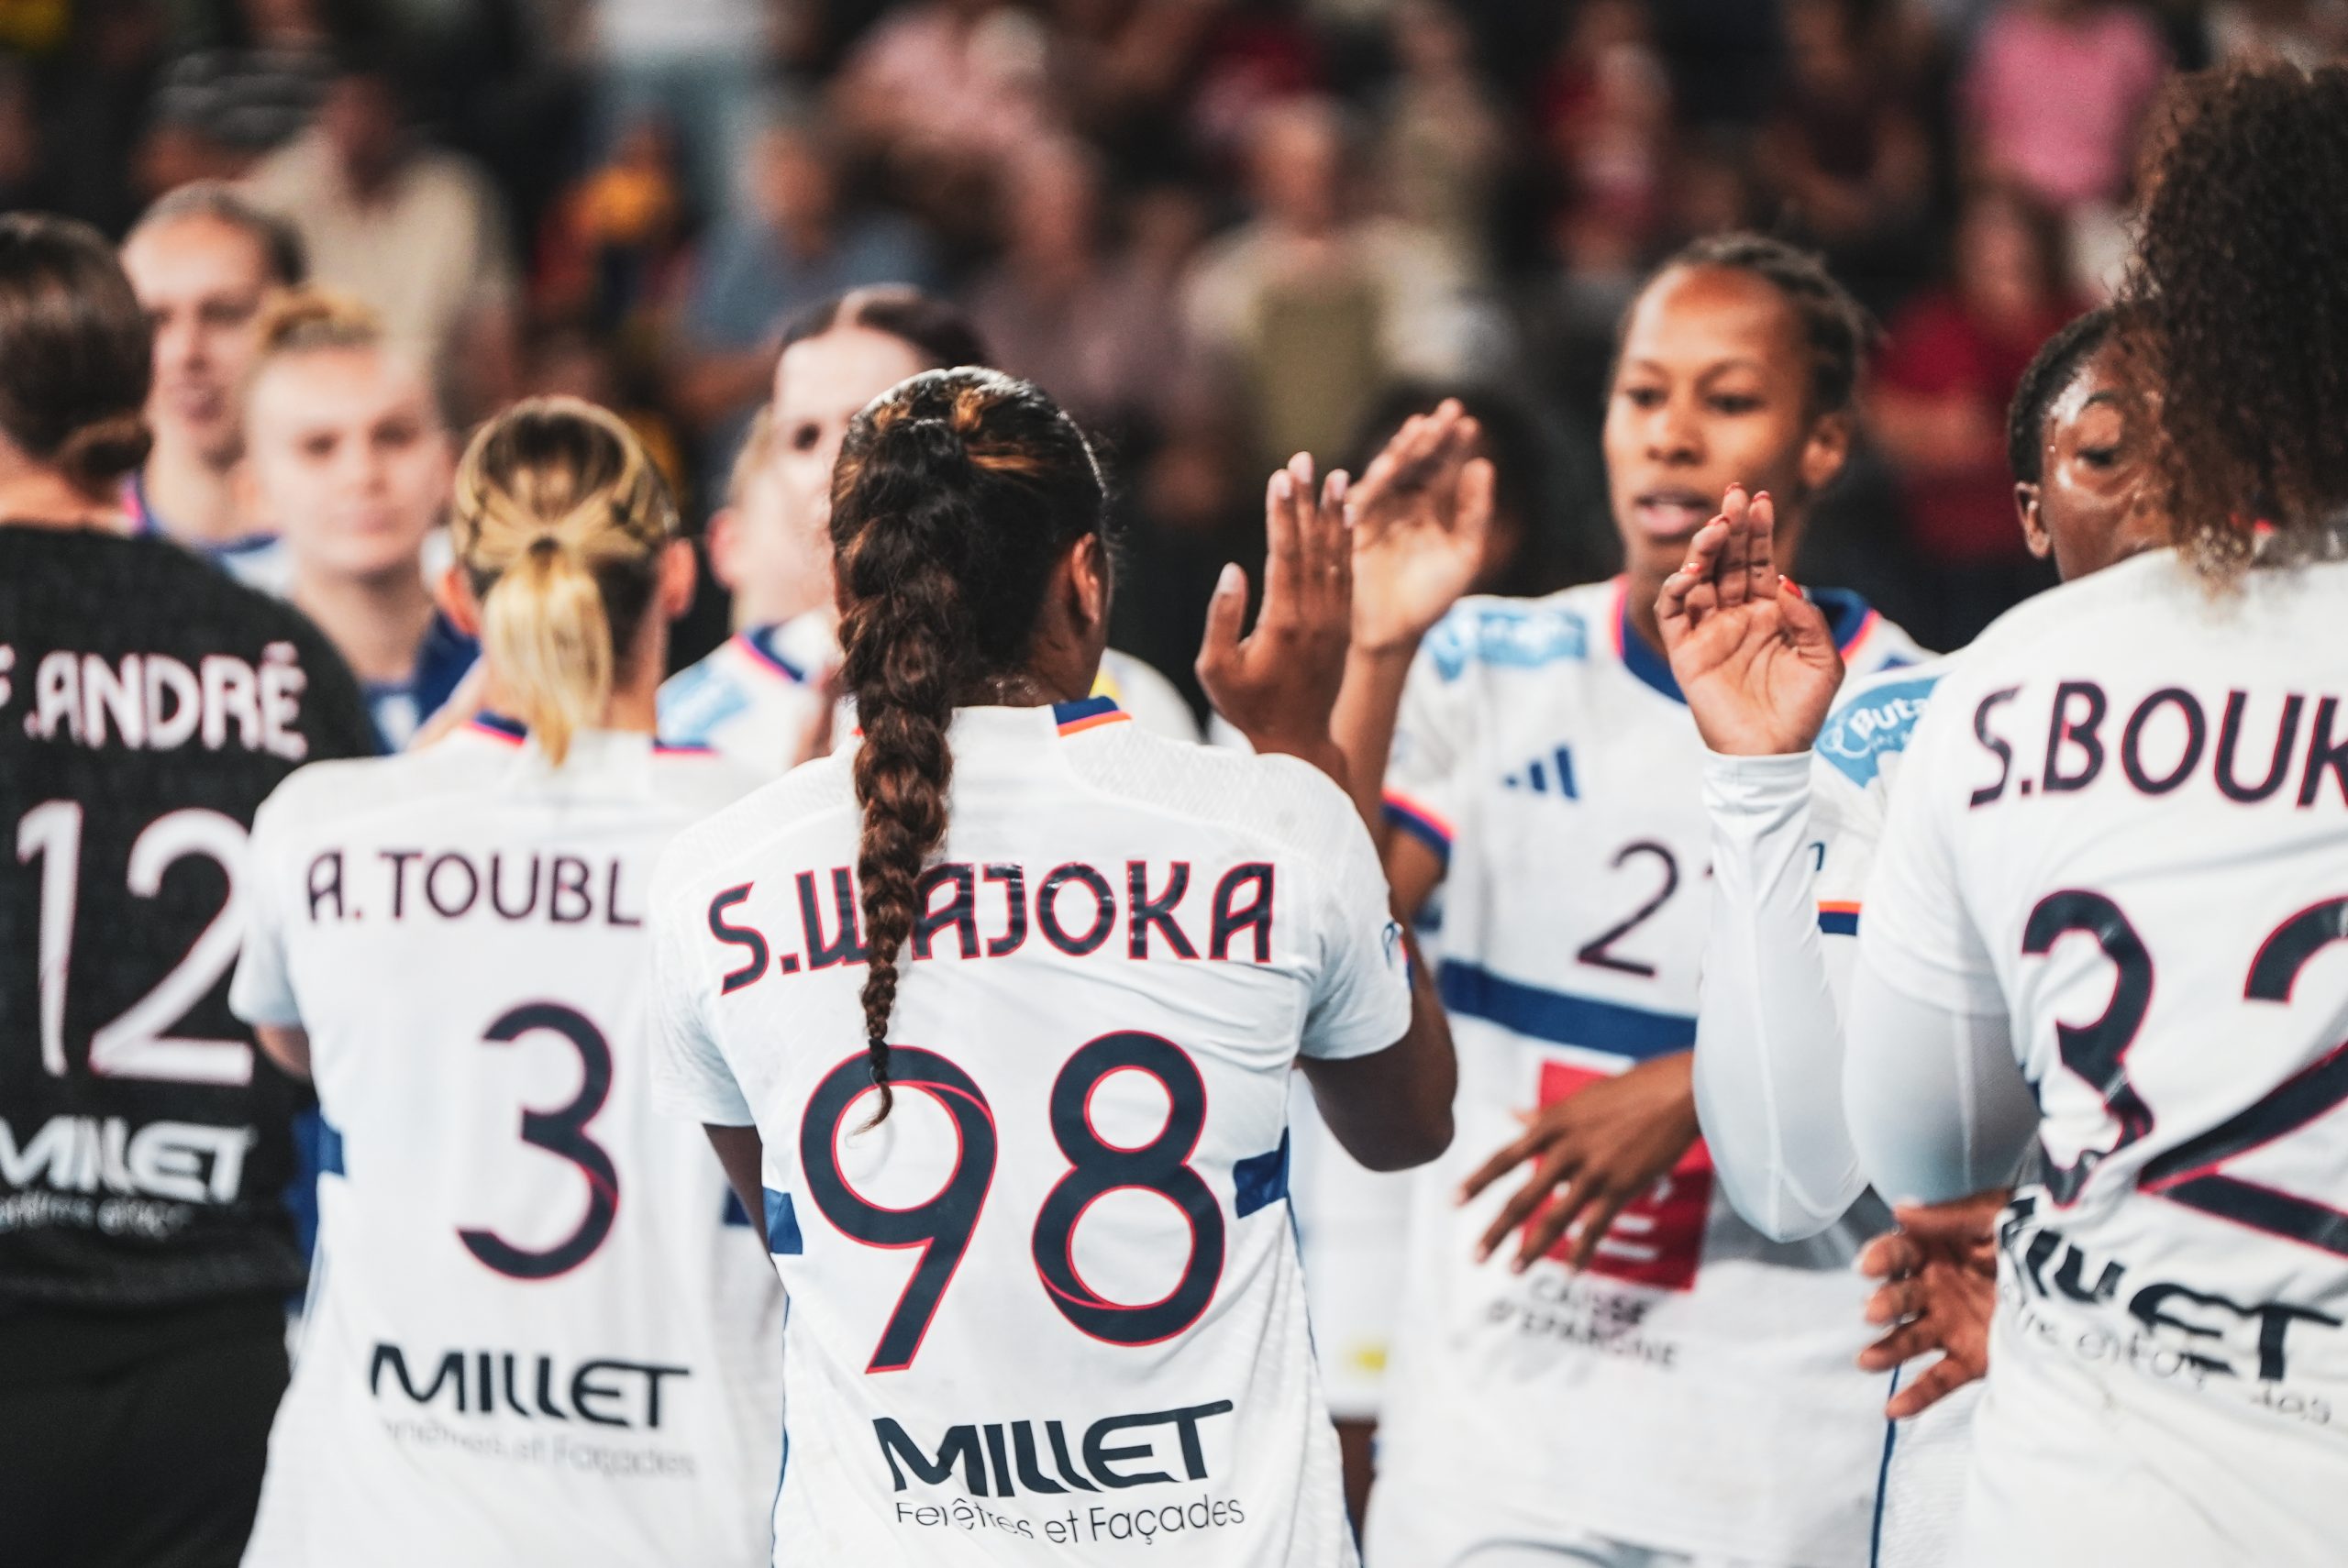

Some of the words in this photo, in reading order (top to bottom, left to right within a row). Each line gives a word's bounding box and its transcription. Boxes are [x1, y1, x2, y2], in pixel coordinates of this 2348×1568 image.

[18, 799, 254, 1086] 12
[707, 860, 1276, 996] S.WAJOKA
[1574, 837, 1713, 979] 2
[456, 1000, 620, 1281] 3
[2021, 889, 2348, 1258] 32
[799, 1029, 1226, 1375] 98
[370, 1342, 692, 1430] MILLET
[872, 1399, 1234, 1497] MILLET
[1045, 1509, 1079, 1544] et
[1089, 1494, 1246, 1546] Façades
